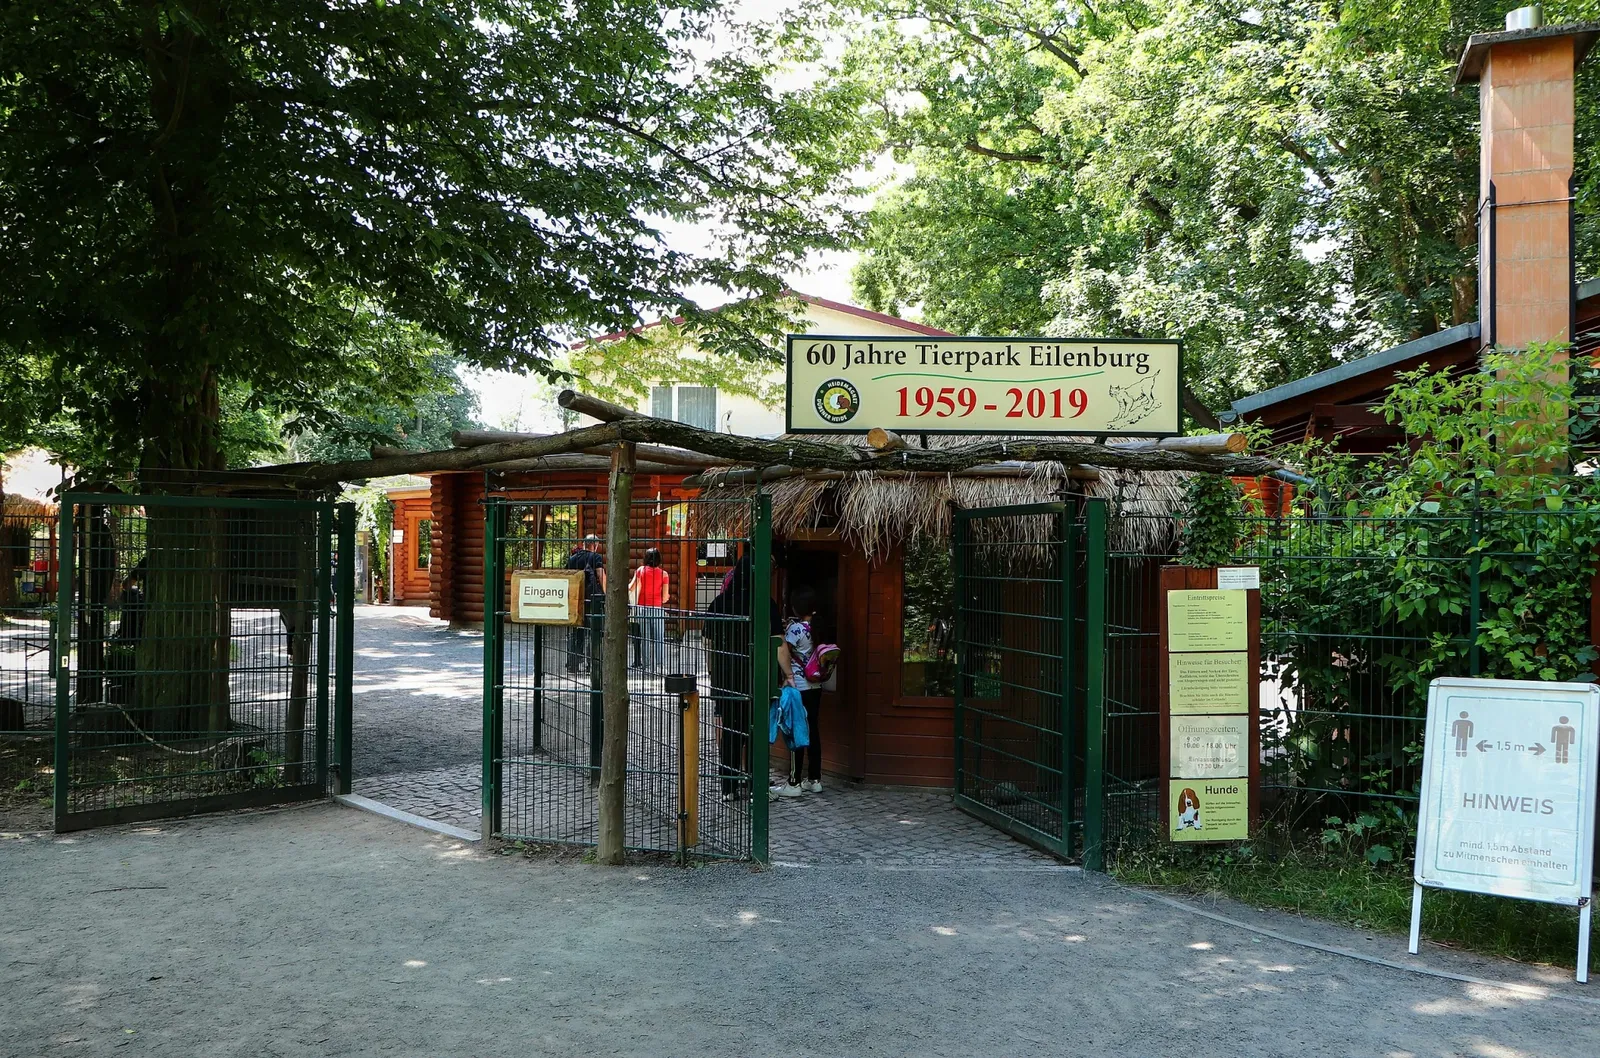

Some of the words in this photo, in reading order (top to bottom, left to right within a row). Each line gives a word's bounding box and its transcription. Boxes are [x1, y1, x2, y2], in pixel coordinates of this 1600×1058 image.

[806, 345, 836, 366] 60
[842, 343, 907, 370] Jahre
[915, 344, 1021, 372] Tierpark
[1029, 344, 1150, 374] Eilenburg
[895, 386, 977, 418] 1959
[1004, 387, 1089, 419] 2019
[524, 586, 564, 599] Eingang
[1187, 594, 1226, 602] Eintrittspreise
[1177, 723, 1239, 735] Öffnungszeiten:
[1514, 744, 1525, 752] m
[1205, 785, 1239, 794] Hunde
[1463, 792, 1555, 815] HINWEIS
[1459, 841, 1485, 850] mind.
[1510, 845, 1552, 857] Abstand
[1443, 850, 1455, 858] zu
[1456, 851, 1520, 865] Mitmenschen
[1521, 860, 1568, 871] einhalten
